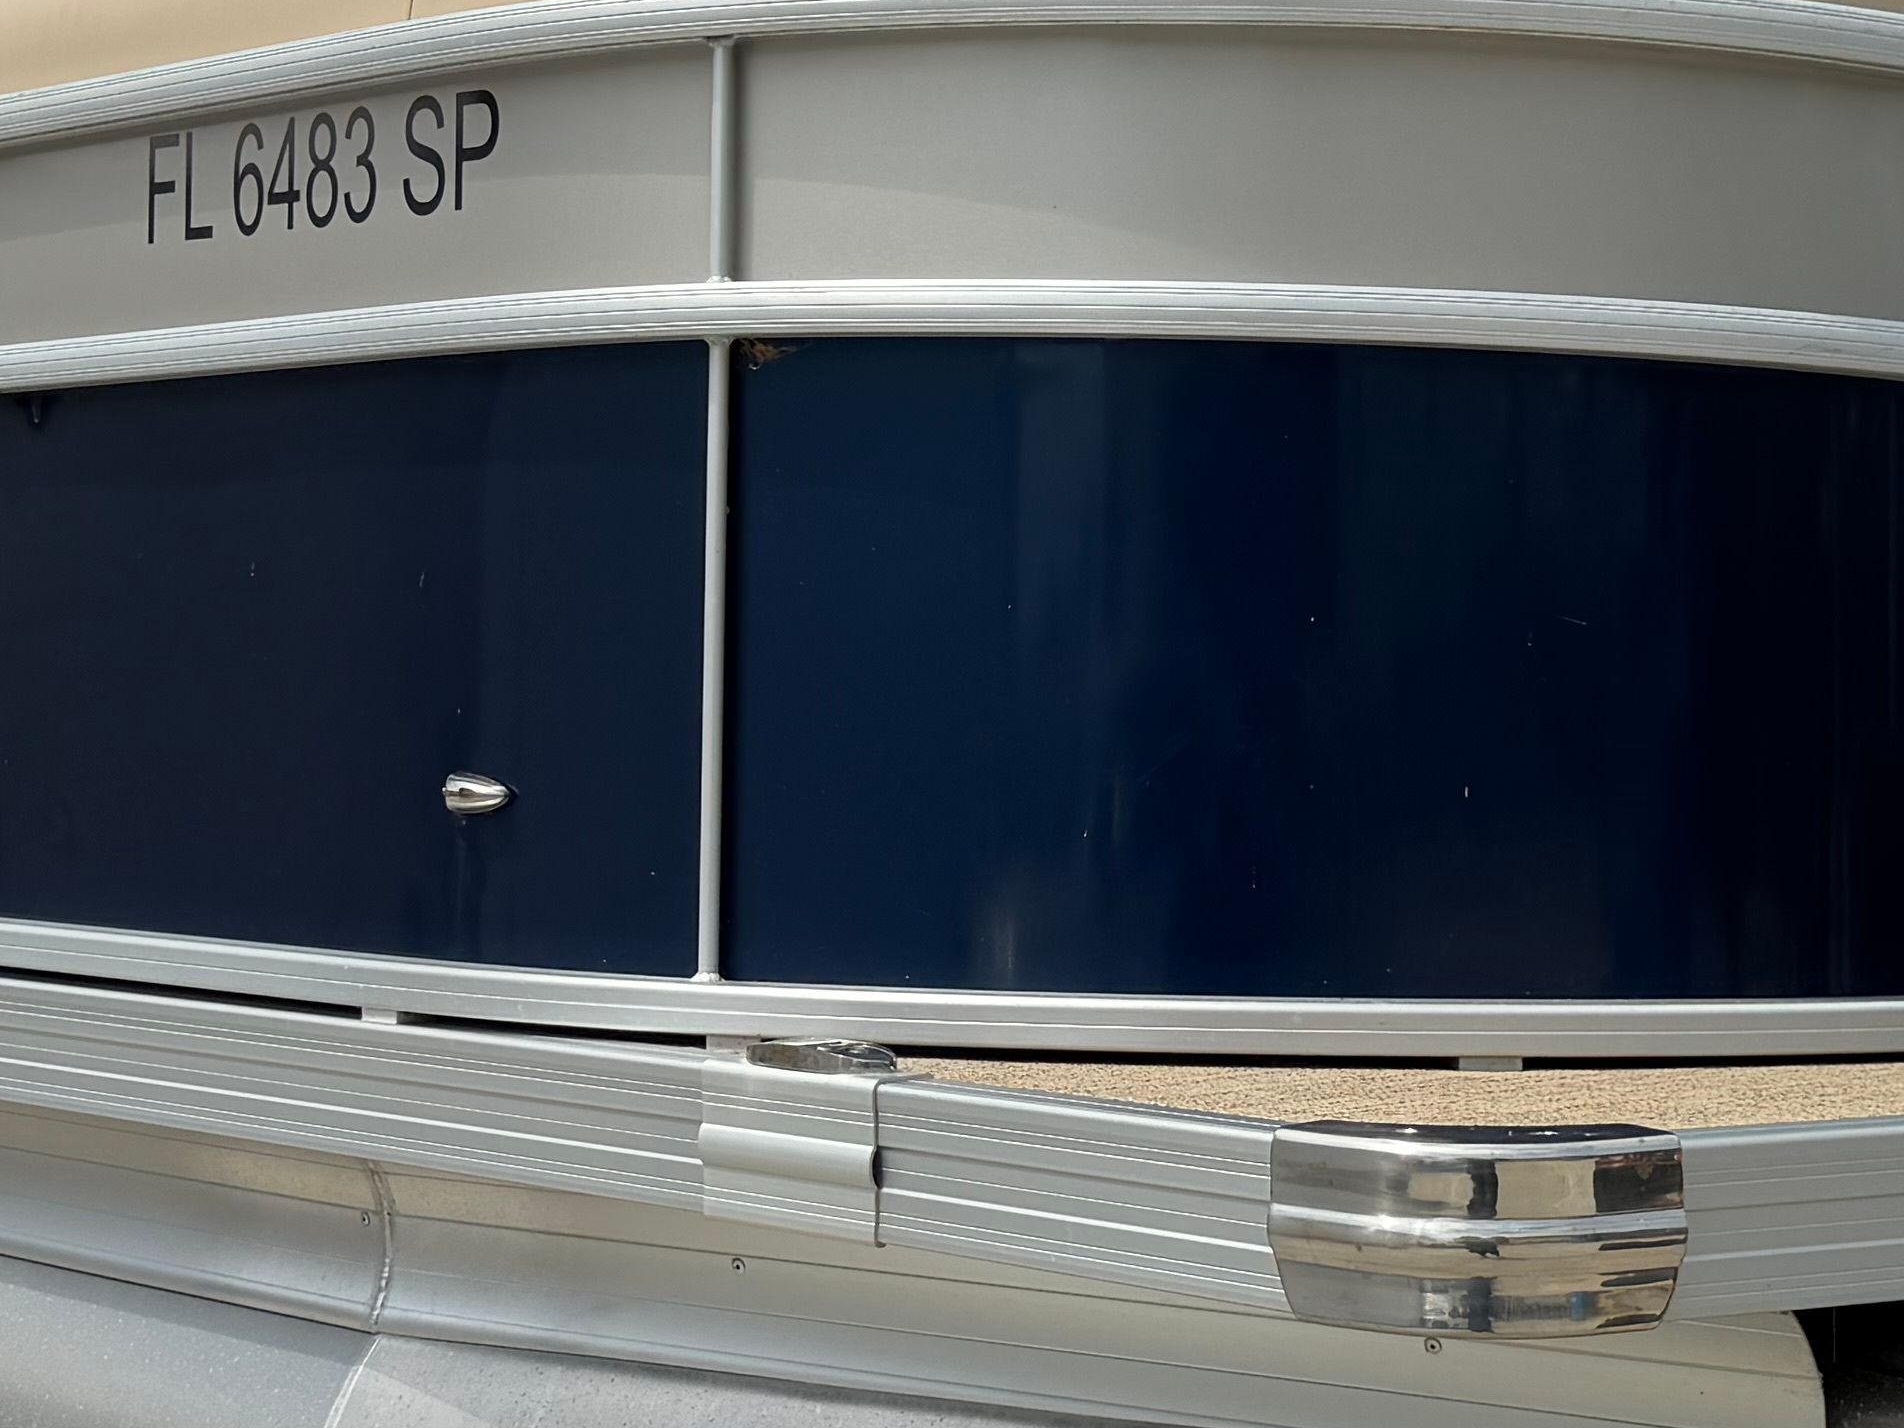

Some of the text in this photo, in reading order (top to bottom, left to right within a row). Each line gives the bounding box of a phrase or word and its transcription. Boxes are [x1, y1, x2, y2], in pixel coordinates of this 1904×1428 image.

[148, 89, 500, 244] FL 6483 SP
